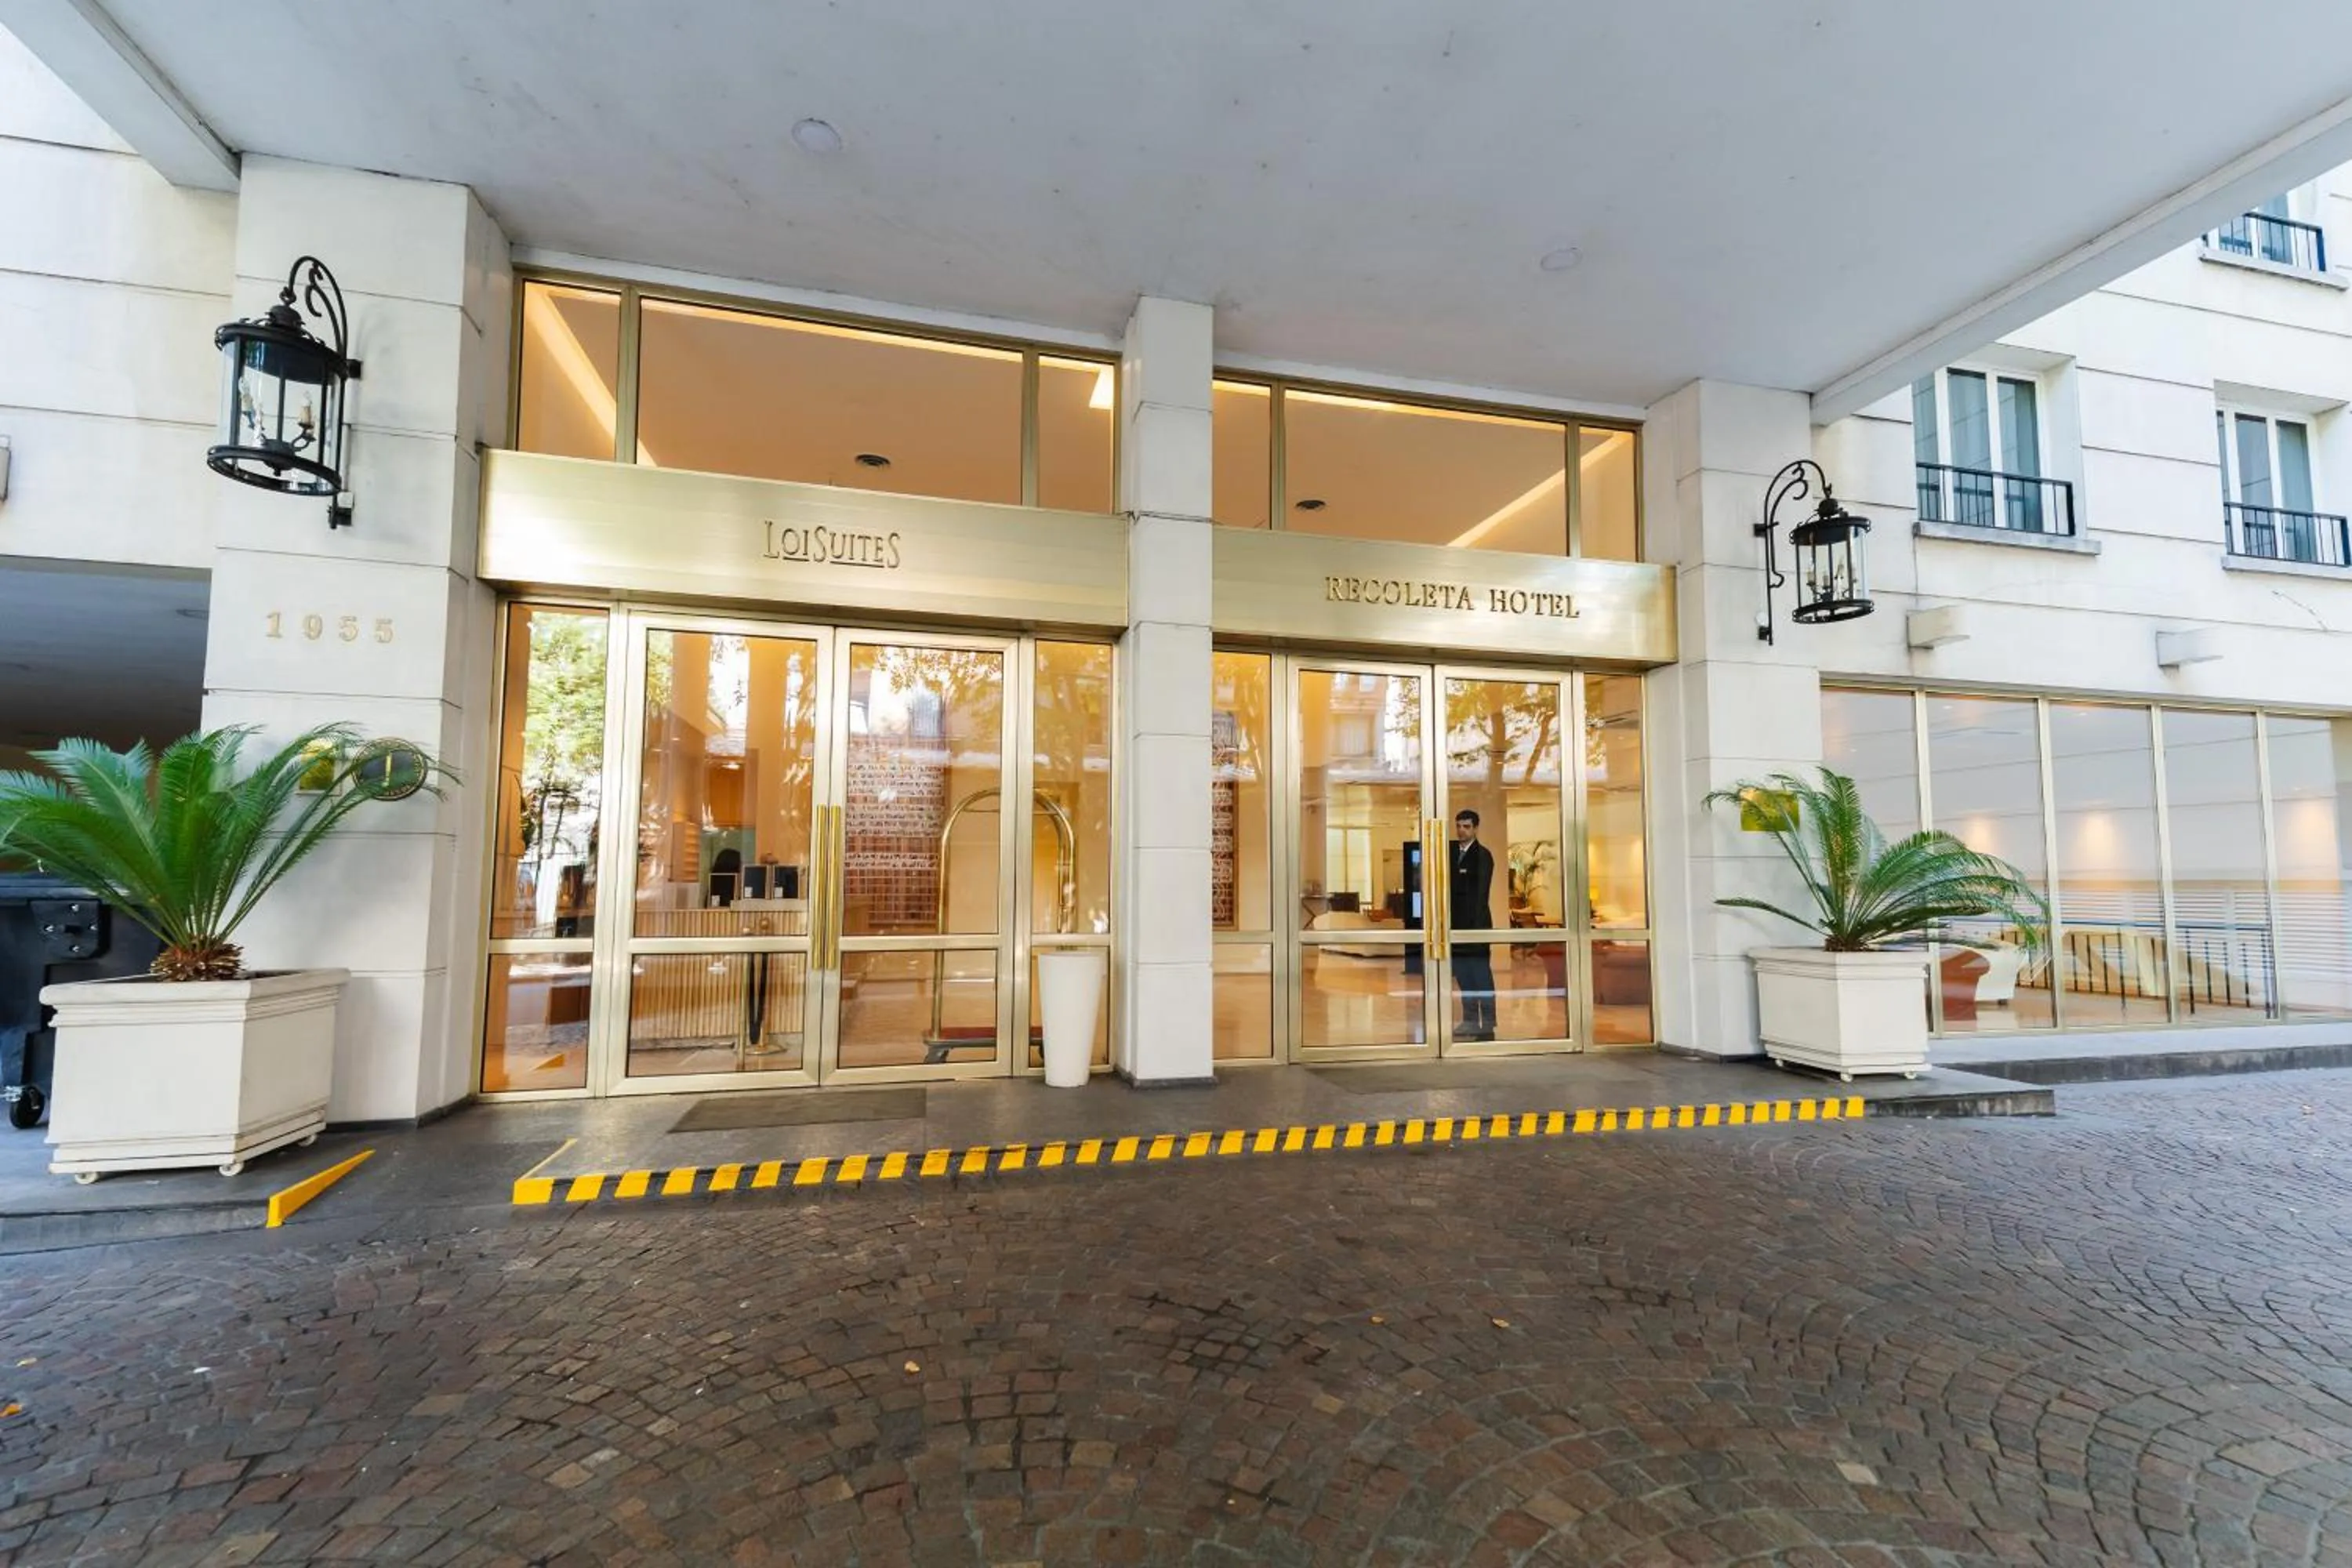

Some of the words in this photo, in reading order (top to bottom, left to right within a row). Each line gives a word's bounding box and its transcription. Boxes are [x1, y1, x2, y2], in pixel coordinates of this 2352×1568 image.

[763, 520, 901, 568] LOISUITES
[1324, 575, 1475, 611] RECOLETA
[1489, 589, 1581, 618] HOTEL
[265, 612, 394, 644] 1955
